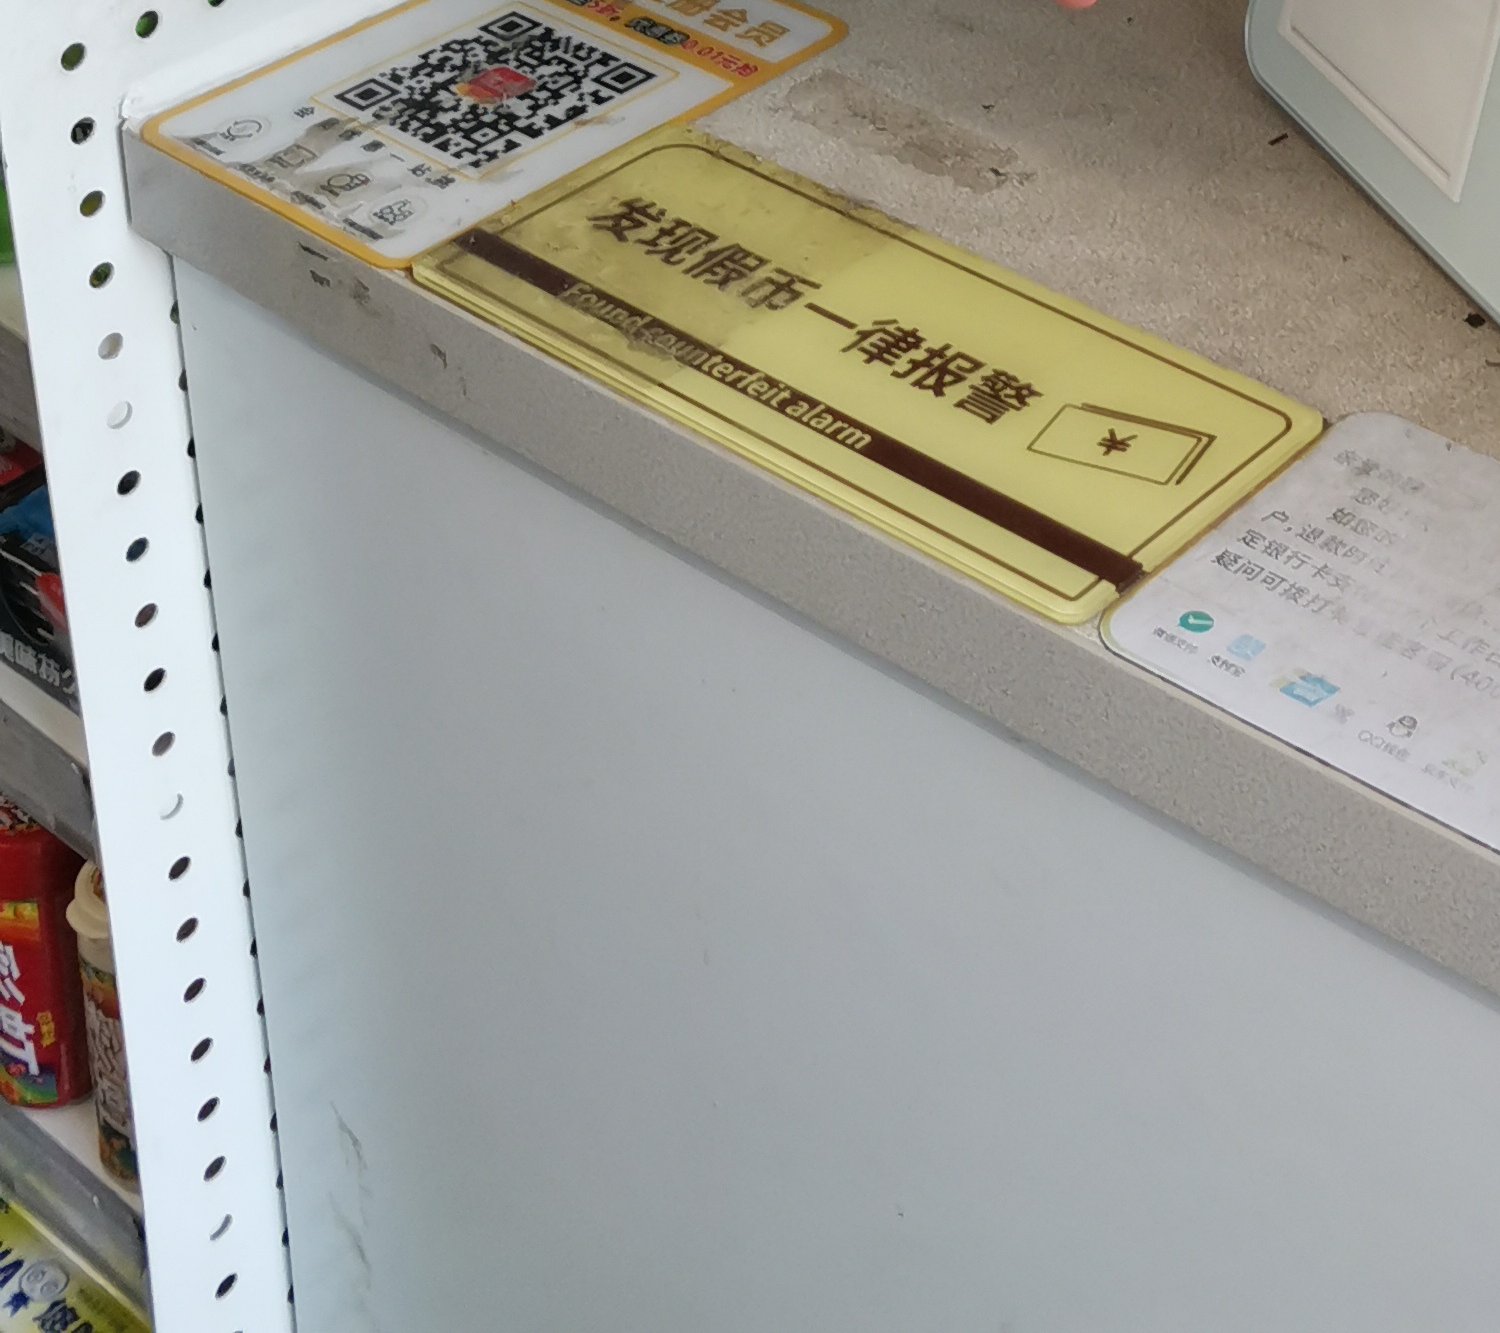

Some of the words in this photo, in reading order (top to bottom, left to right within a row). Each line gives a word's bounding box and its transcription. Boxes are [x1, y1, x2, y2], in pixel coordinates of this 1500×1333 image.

[586, 196, 1046, 426] 发现假币一律报警
[784, 395, 873, 451] alarm
